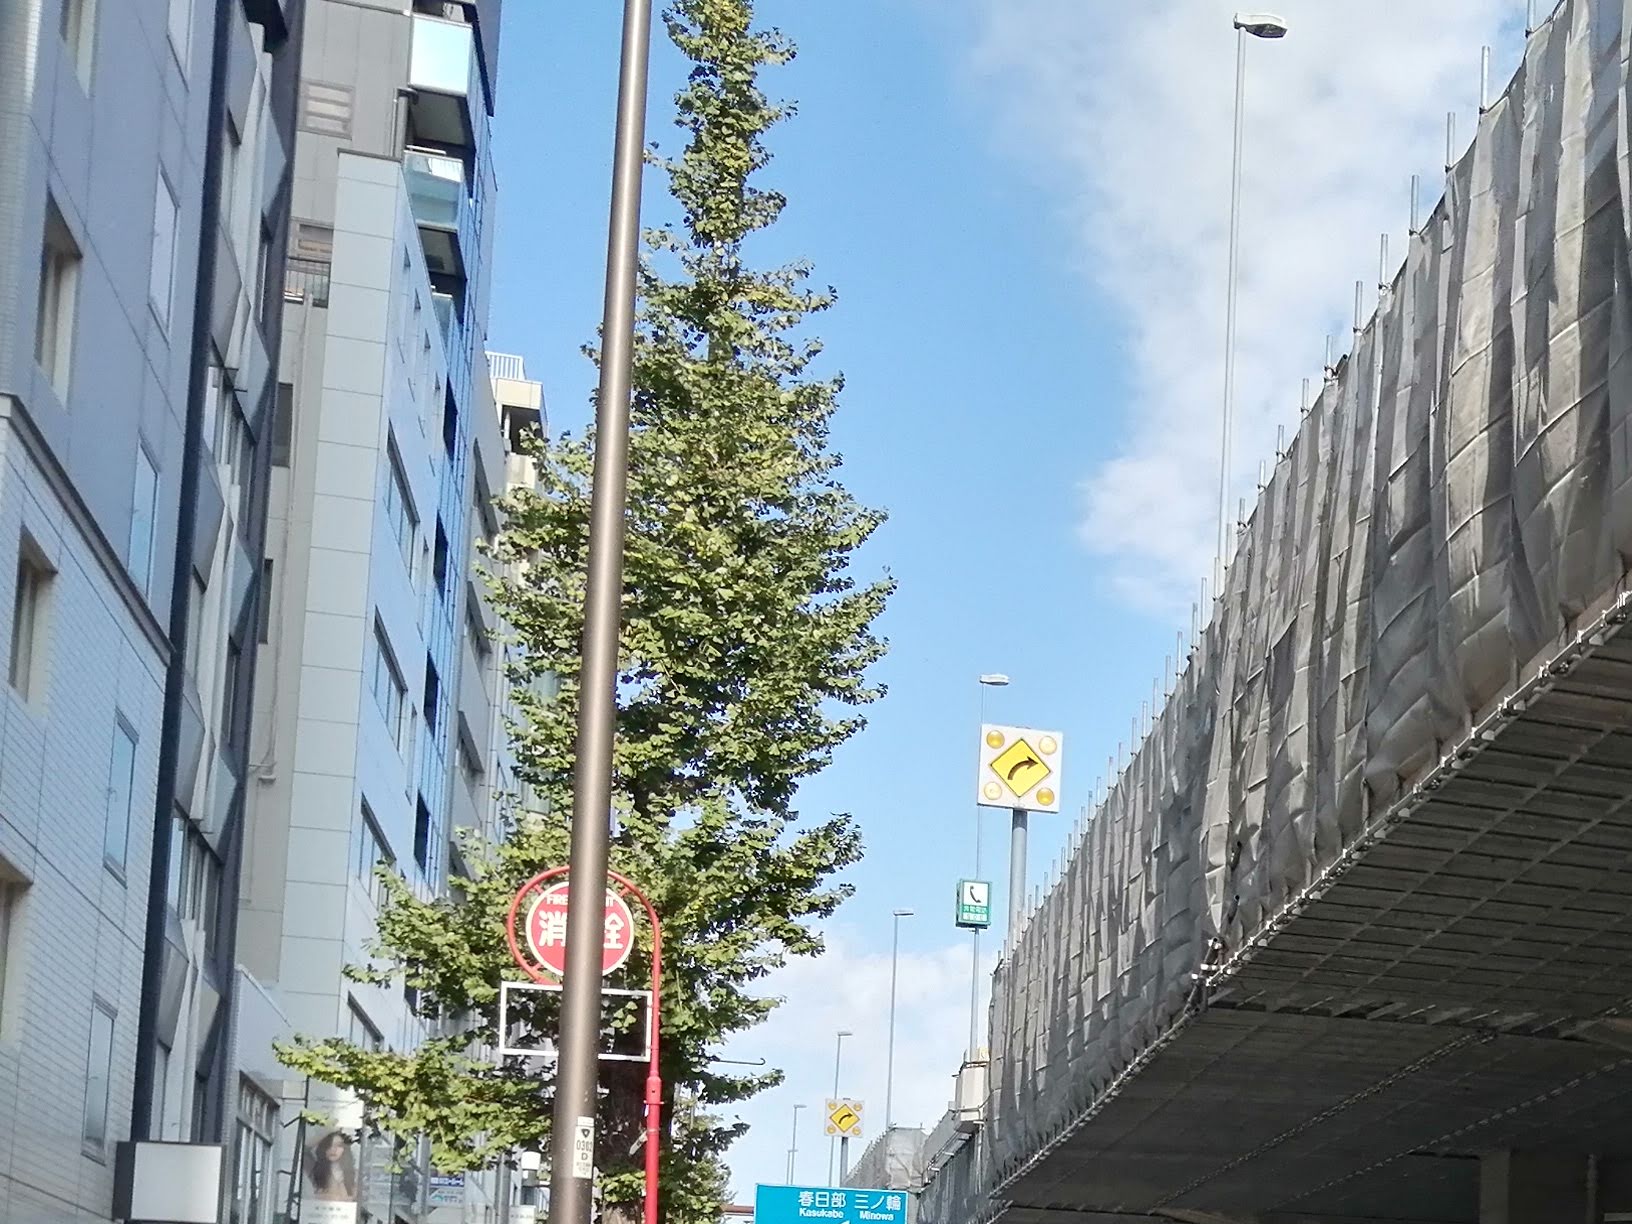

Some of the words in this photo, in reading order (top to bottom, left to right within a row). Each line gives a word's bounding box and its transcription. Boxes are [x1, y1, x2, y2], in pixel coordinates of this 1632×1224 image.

[798, 1191, 846, 1208] 春日部
[854, 1194, 901, 1211] 三ノ輪
[799, 1208, 844, 1219] Kasukabe
[859, 1210, 894, 1221] Minowa
